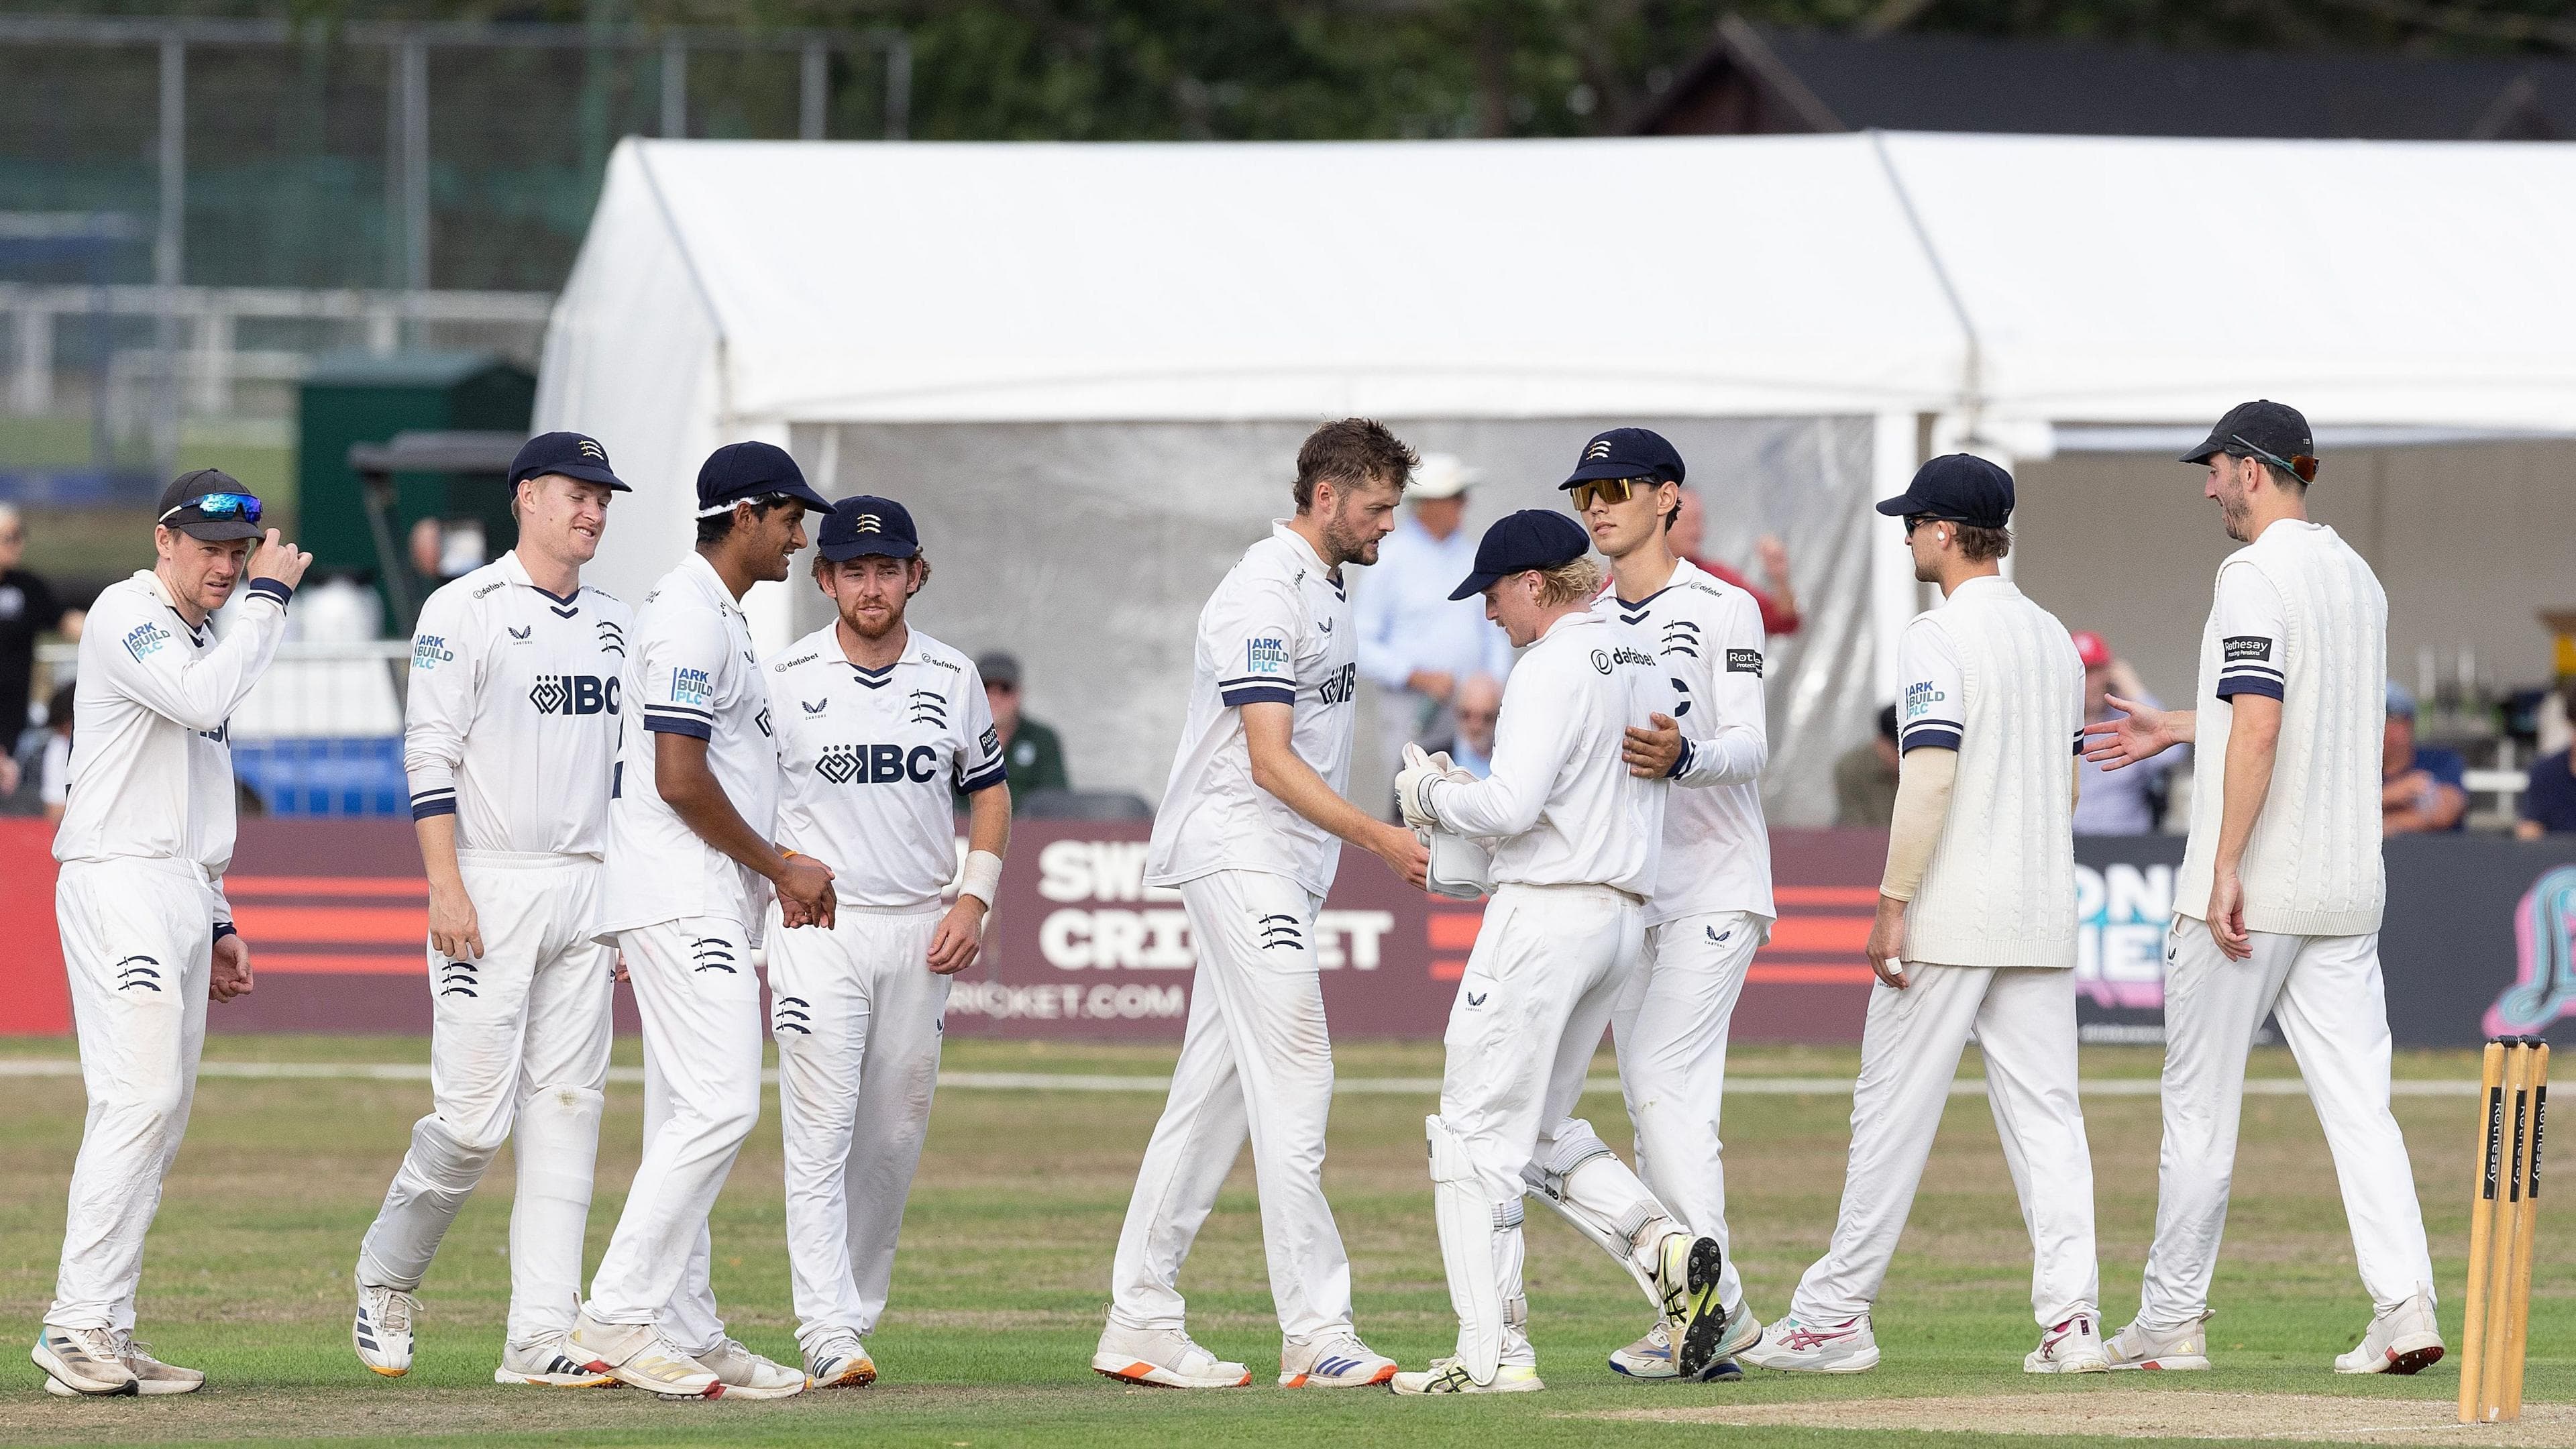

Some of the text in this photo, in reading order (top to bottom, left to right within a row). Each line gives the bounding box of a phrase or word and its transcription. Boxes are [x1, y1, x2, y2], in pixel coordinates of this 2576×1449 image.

[1699, 584, 1723, 598] dafabet
[128, 622, 156, 643] ARK
[131, 630, 171, 652] BUILD
[419, 635, 445, 649] ARK
[1252, 638, 1283, 651] ARK
[2224, 639, 2268, 652] Rothesay
[137, 641, 164, 660] PLC
[417, 646, 453, 662] BUILD
[1252, 650, 1289, 663] BUILD
[1613, 647, 1656, 666] dafabet
[415, 657, 436, 669] PLC
[787, 653, 818, 667] dafabet
[932, 659, 961, 674] dafabet
[1252, 661, 1278, 672] PLC
[678, 668, 709, 683] ARK
[1337, 662, 1356, 702] IB
[678, 679, 712, 696] BUILD
[1909, 680, 1933, 696] ARK
[561, 676, 621, 715] IBC
[676, 691, 702, 705] PLC
[1909, 692, 1945, 707] BUILD
[1909, 703, 1928, 718] PLC
[981, 728, 997, 746] Roth
[855, 745, 937, 784] IBC
[1038, 908, 1395, 971] CRIET
[945, 980, 1185, 1020] RICKET.COM
